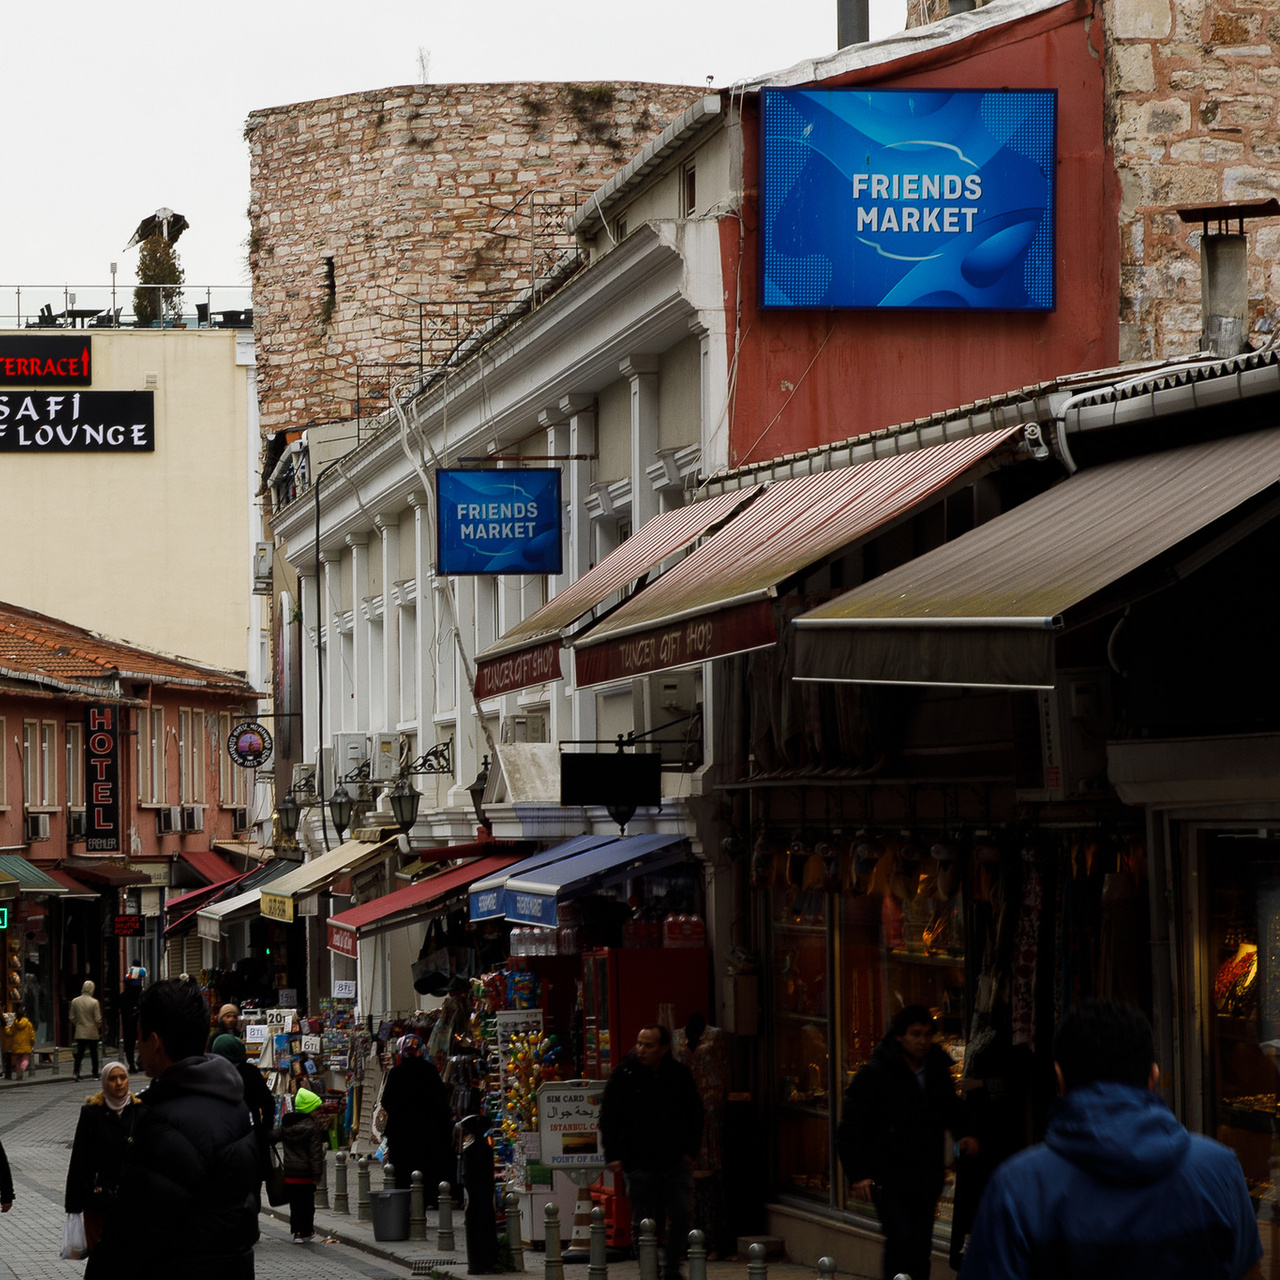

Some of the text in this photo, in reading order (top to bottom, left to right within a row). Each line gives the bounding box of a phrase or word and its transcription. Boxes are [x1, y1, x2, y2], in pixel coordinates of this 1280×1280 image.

[852, 173, 983, 201] FRIENDS
[856, 206, 978, 233] MARKET
[17, 423, 148, 446] LOUNGE
[457, 502, 538, 520] FRIENDS
[460, 522, 536, 539] MARKET
[619, 637, 656, 670] TUNCER
[89, 708, 113, 829] HOTEL
[268, 1013, 286, 1024] 20T
[303, 1040, 319, 1050] 6TL
[546, 1095, 561, 1103] SIM
[550, 1123, 587, 1131] ISTANBUL
[551, 1156, 575, 1164] POINT
